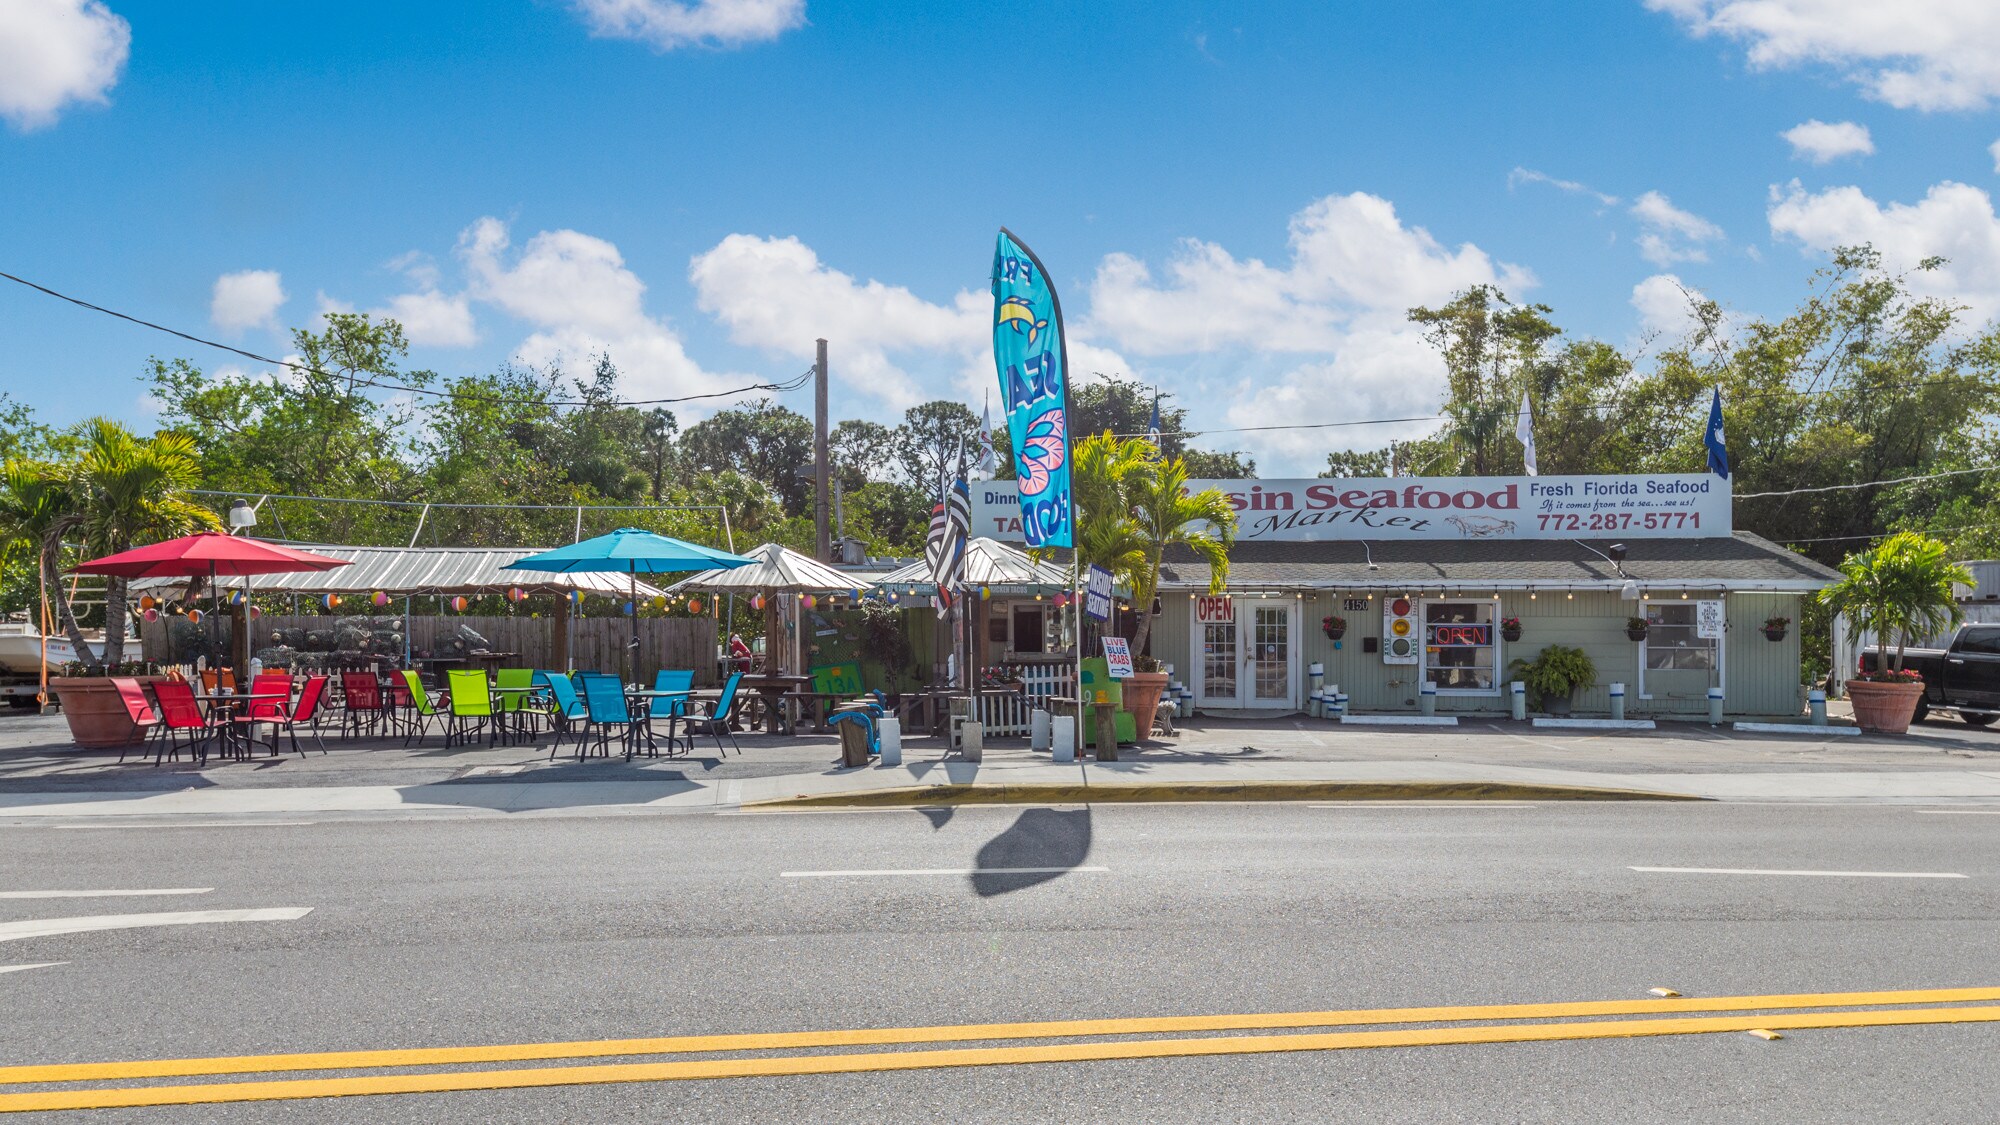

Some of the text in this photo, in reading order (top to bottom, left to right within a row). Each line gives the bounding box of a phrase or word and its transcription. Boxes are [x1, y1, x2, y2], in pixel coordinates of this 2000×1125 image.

[1530, 479, 1710, 497] Fresh Florida Seafood
[1226, 484, 1521, 511] sin Seafood
[1539, 498, 1553, 512] If
[1556, 499, 1564, 509] it
[1565, 501, 1591, 509] comes
[1592, 498, 1616, 512] from
[1621, 498, 1635, 508] the
[1679, 496, 1696, 507] us!
[993, 517, 1023, 533] TA
[1248, 506, 1432, 538] Market
[1537, 511, 1700, 531] 772-287-5771
[1089, 567, 1112, 598] INSIDE
[1087, 592, 1110, 618] SEATING
[1198, 597, 1232, 621] OPEN
[1344, 600, 1368, 610] 4150
[1104, 637, 1125, 647] LIVE
[1437, 626, 1486, 644] OPEN
[1107, 646, 1127, 655] BLUE
[1108, 653, 1130, 665] CRABS
